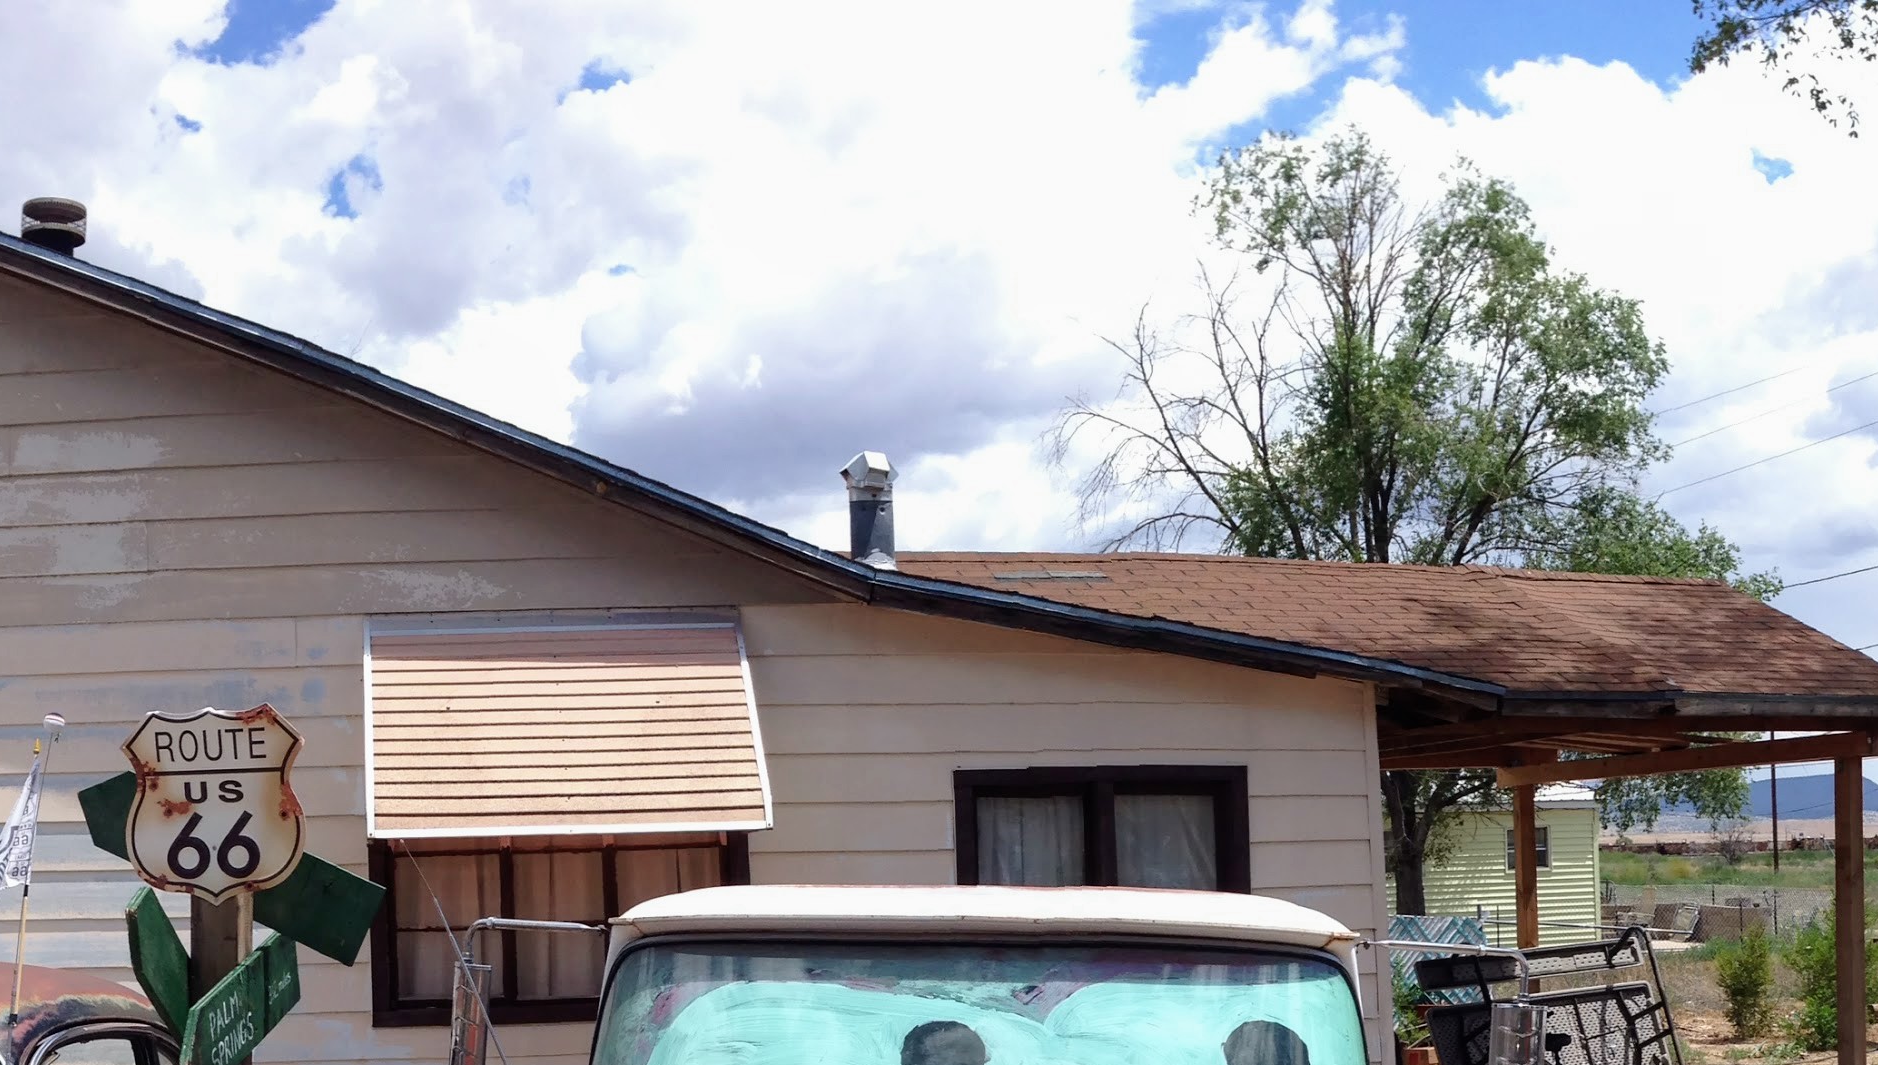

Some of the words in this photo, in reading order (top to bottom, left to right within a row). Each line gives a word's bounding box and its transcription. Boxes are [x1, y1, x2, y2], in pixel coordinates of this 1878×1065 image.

[154, 727, 268, 763] ROUTE
[184, 780, 245, 804] US
[167, 810, 261, 880] 66
[209, 990, 240, 1043] PALM
